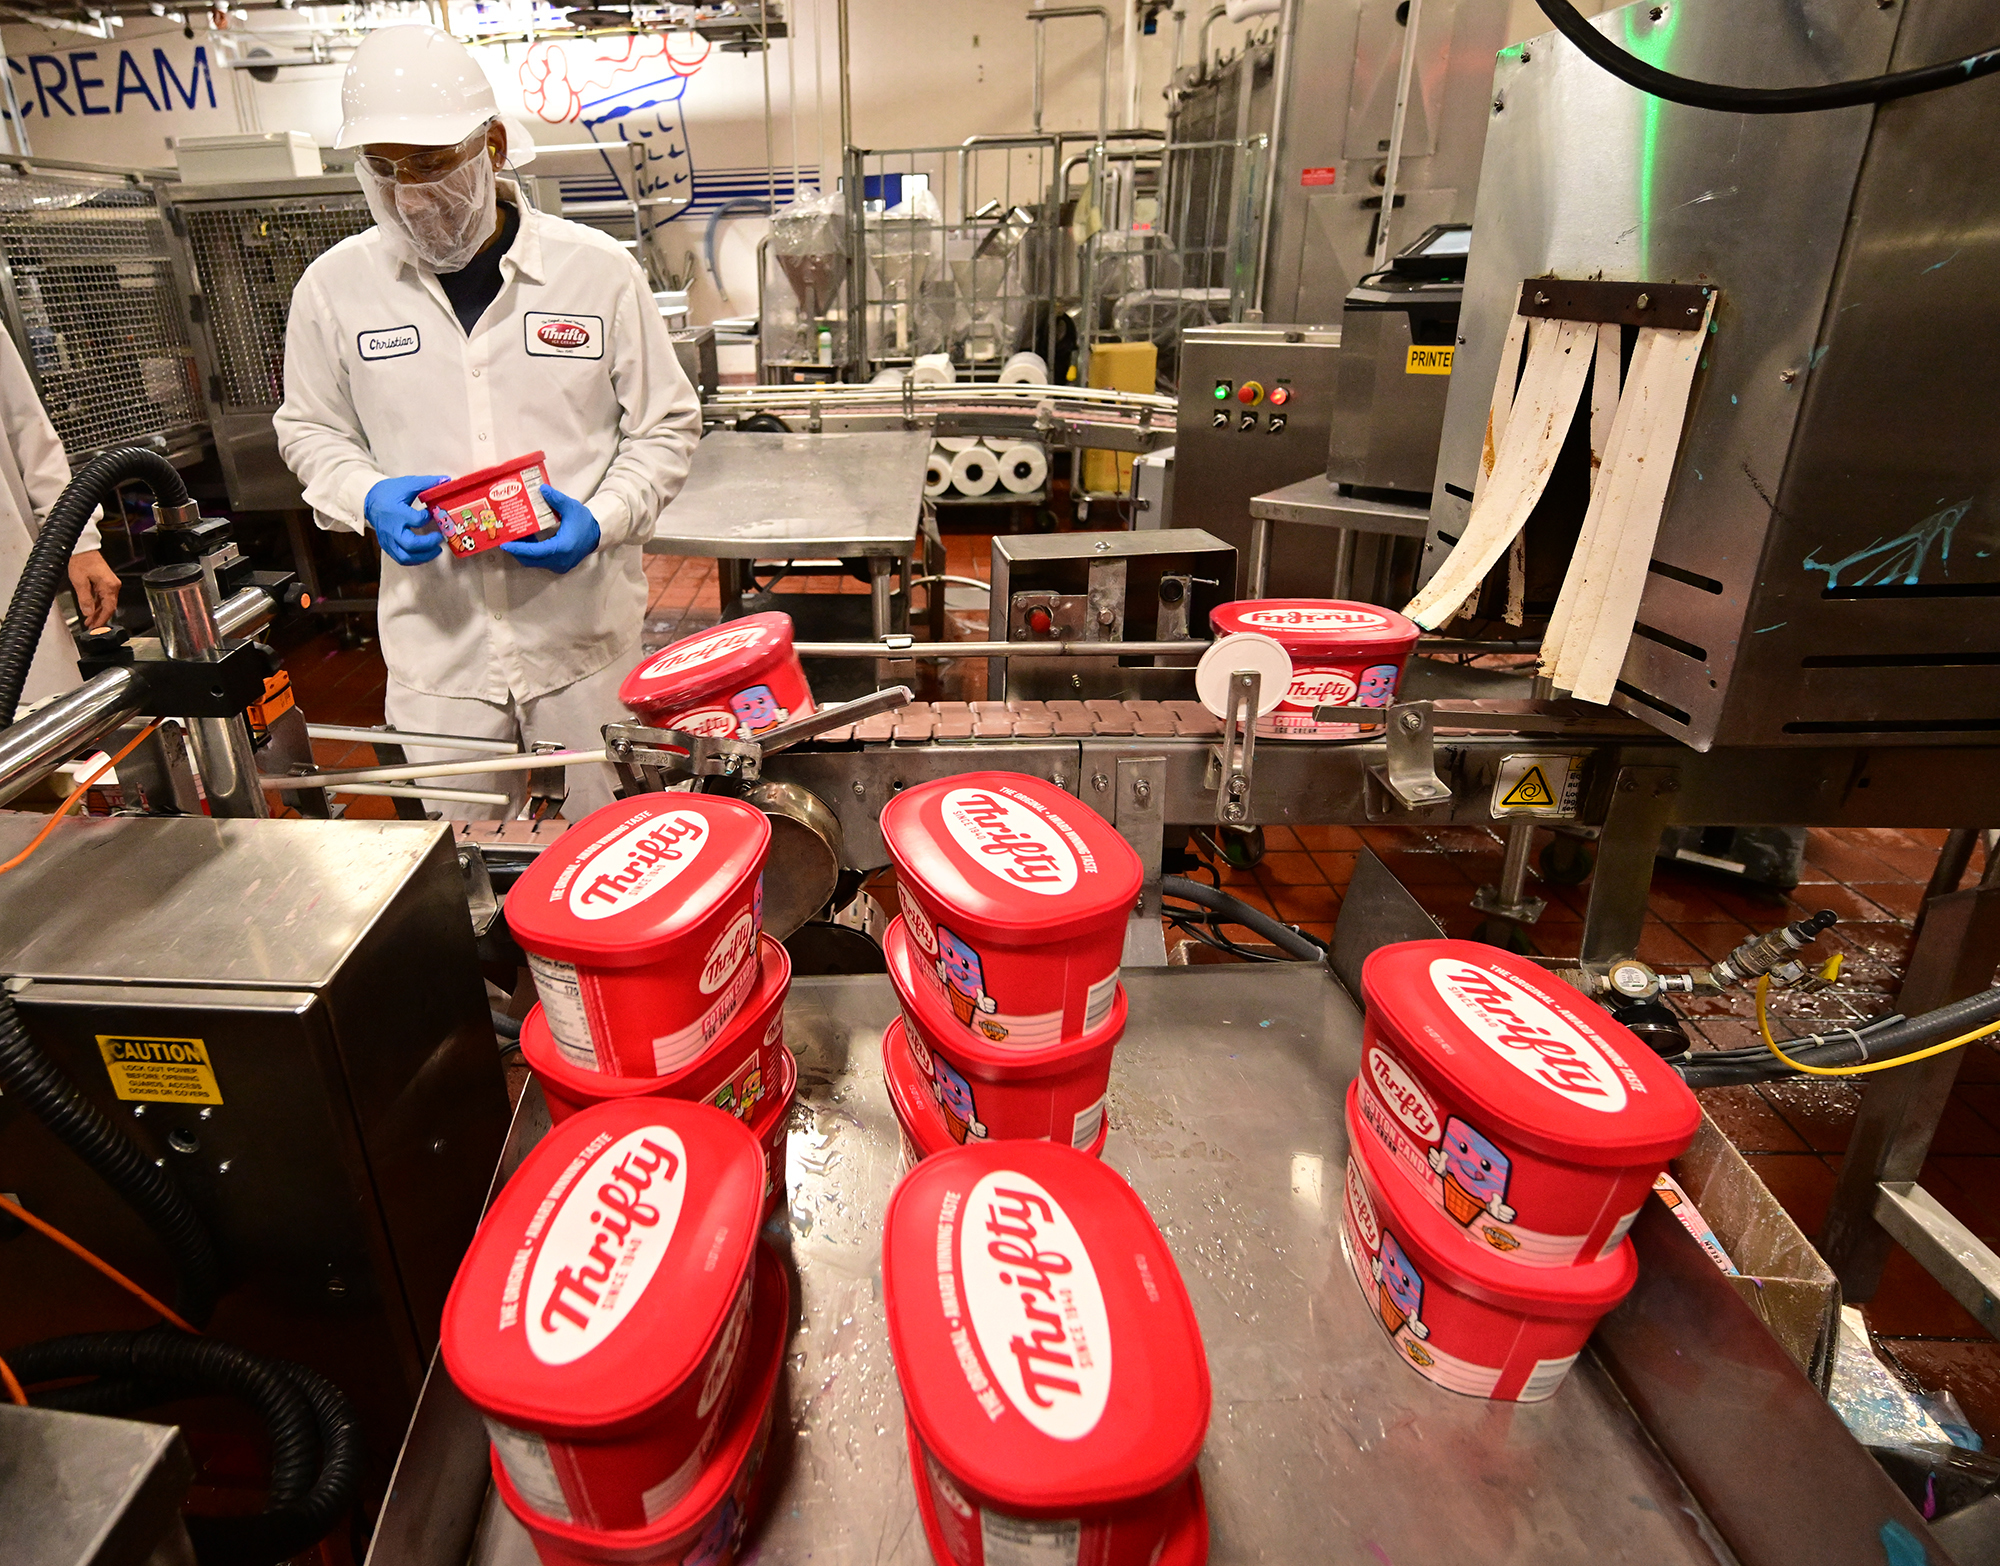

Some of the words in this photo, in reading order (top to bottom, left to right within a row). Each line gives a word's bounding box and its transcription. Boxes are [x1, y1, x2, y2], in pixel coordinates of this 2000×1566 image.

[369, 336, 414, 350] Christian
[541, 327, 587, 344] Thrifty
[1411, 351, 1454, 368] PRINTE
[491, 484, 520, 498] Thrifty
[1251, 611, 1374, 623] Thrifty
[653, 632, 756, 674] Thrifty
[1287, 681, 1352, 702] Thrifty
[677, 714, 731, 737] rifty
[595, 822, 630, 849] WINNING
[626, 810, 653, 828] TASTE
[952, 810, 975, 828] SINCE
[970, 825, 988, 842] 1940
[956, 794, 1063, 883] Thrifty
[999, 786, 1017, 797] THE
[1013, 791, 1049, 813] ORIGINAL
[1048, 814, 1072, 834] AWARD
[1065, 829, 1089, 855] WINNING
[1080, 852, 1098, 874] TASTE
[554, 863, 581, 893] ORIGINAL
[580, 816, 704, 906] Thrifty
[628, 878, 652, 896] SINCE
[648, 864, 666, 880] 1940
[549, 889, 564, 903] THE
[898, 886, 934, 951] Thrifty
[705, 921, 751, 985] Thrifty
[703, 990, 735, 1032] COTTON
[1447, 986, 1477, 1011] SINCE
[1473, 1006, 1499, 1029] 1940
[1446, 968, 1610, 1098] Thrifty
[1489, 964, 1511, 979] THE
[1509, 970, 1555, 1008] ORIGINAL
[1554, 1009, 1595, 1043] AWARD
[1588, 1035, 1627, 1073] WINNING
[1616, 1062, 1648, 1094] TASTE
[112, 1042, 201, 1063] CAUTION
[128, 1087, 159, 1095] DOORS
[160, 1088, 173, 1096] OR
[175, 1089, 210, 1098] COVERS
[161, 1073, 199, 1081] OPENING
[168, 1081, 202, 1089] ACCESS
[1374, 1053, 1434, 1136] Thrifty
[580, 1131, 614, 1162] TASTE
[1365, 1093, 1397, 1142] COTTON
[1397, 1136, 1434, 1182] CANDY
[546, 1158, 588, 1200] WINNING
[525, 1199, 557, 1239] AWARD
[939, 1190, 961, 1223] TASTE
[1348, 1162, 1376, 1245] Thrifty
[540, 1137, 680, 1334] Thrifty
[937, 1223, 953, 1273] WINNING
[1704, 1240, 1722, 1264] CREAM
[502, 1246, 534, 1303] ORIGINAL
[601, 1270, 628, 1311] SINCE
[938, 1273, 961, 1318] AWARD
[985, 1187, 1083, 1410] Thrifty
[499, 1302, 518, 1332] THE
[951, 1326, 989, 1391] ORIGINAL
[1069, 1326, 1094, 1369] SINCE
[976, 1386, 1005, 1423] THE
